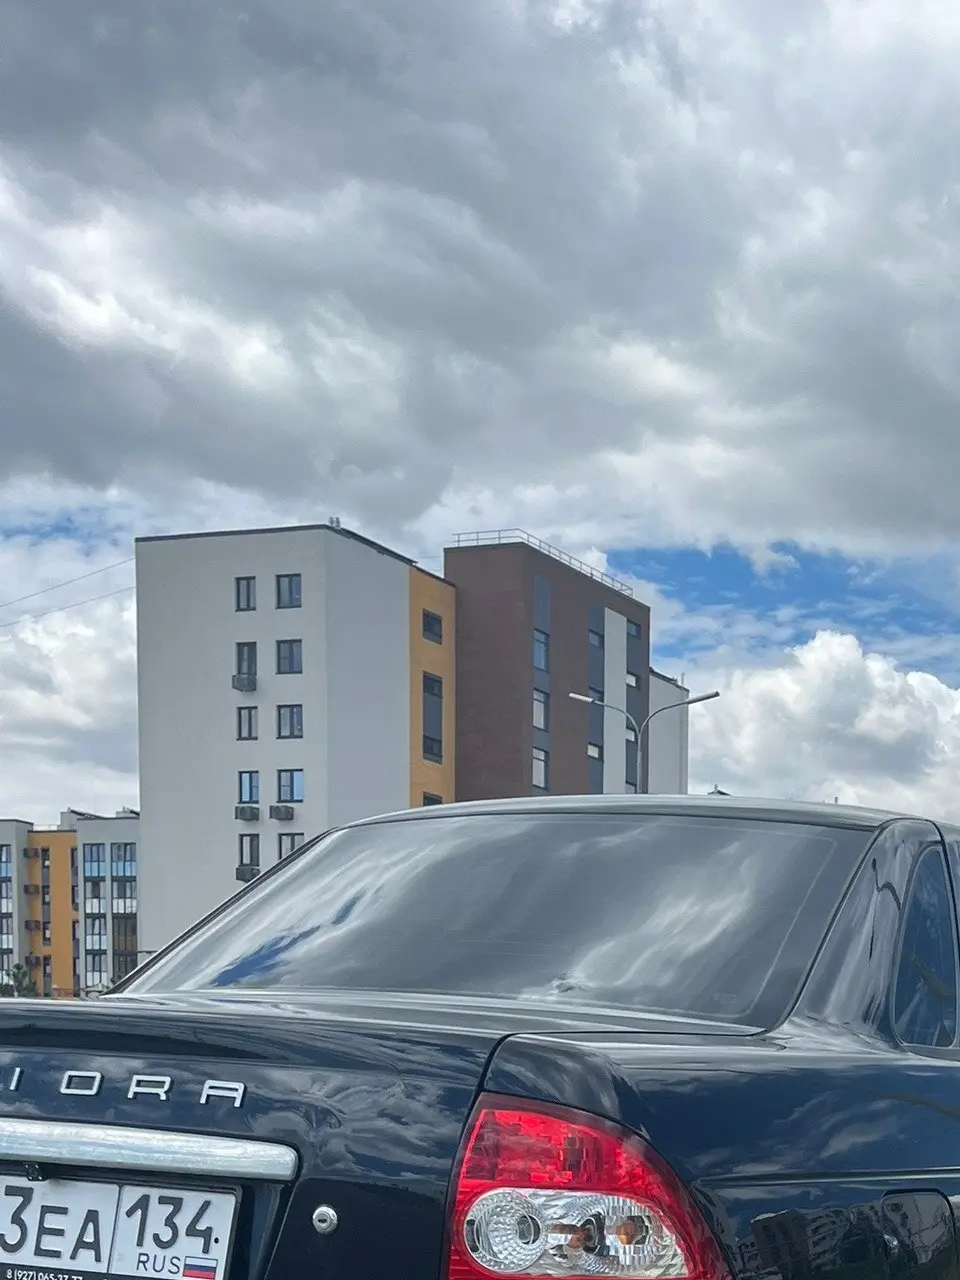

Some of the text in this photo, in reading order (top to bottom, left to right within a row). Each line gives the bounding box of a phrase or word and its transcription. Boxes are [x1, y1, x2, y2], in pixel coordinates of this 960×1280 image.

[125, 1194, 213, 1254] 134
[6, 1269, 13, 1279] 8
[136, 1253, 180, 1275] RUS
